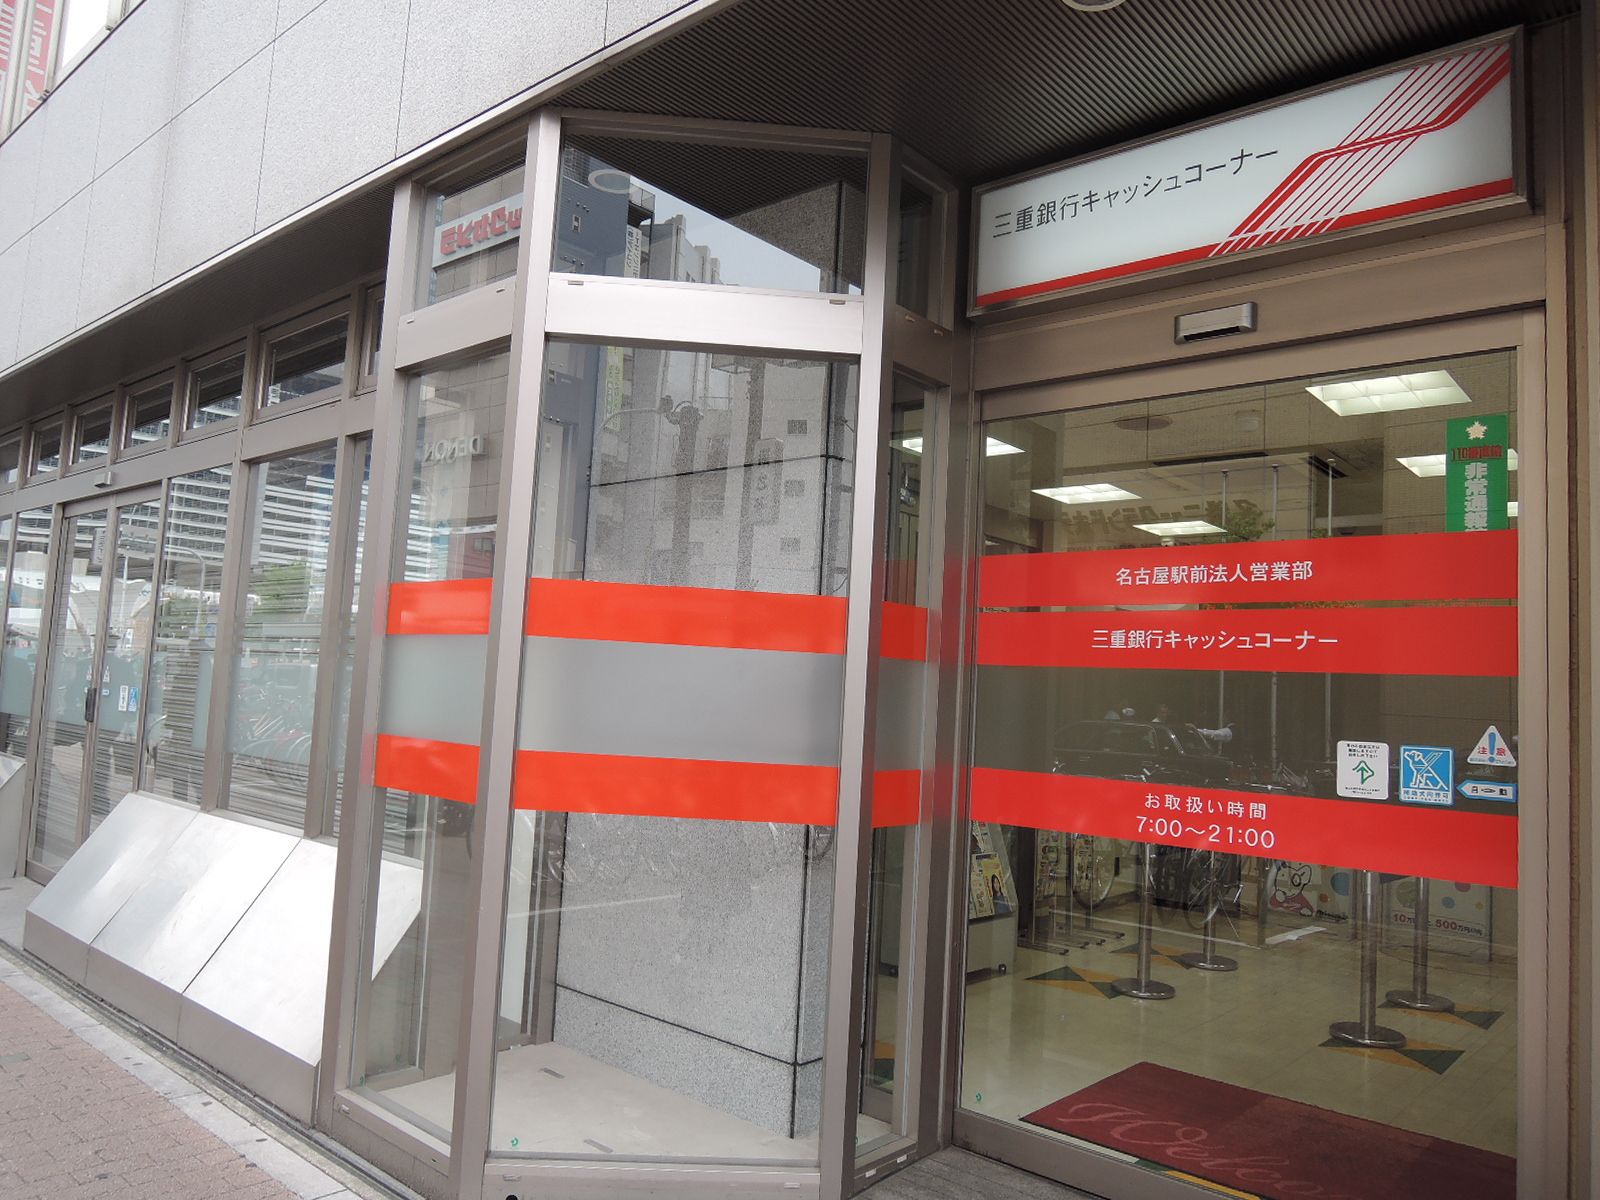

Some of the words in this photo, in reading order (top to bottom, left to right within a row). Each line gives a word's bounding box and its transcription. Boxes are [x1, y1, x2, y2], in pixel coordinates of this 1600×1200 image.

[992, 148, 1279, 239] 三重銀行キャッシュコーナー
[1464, 462, 1488, 532] 非常通報
[1115, 560, 1314, 586] 名古屋駅前法人営業部
[1092, 629, 1339, 651] 三重銀行キャッシュコーナー
[1144, 792, 1267, 821] お取扱い時間
